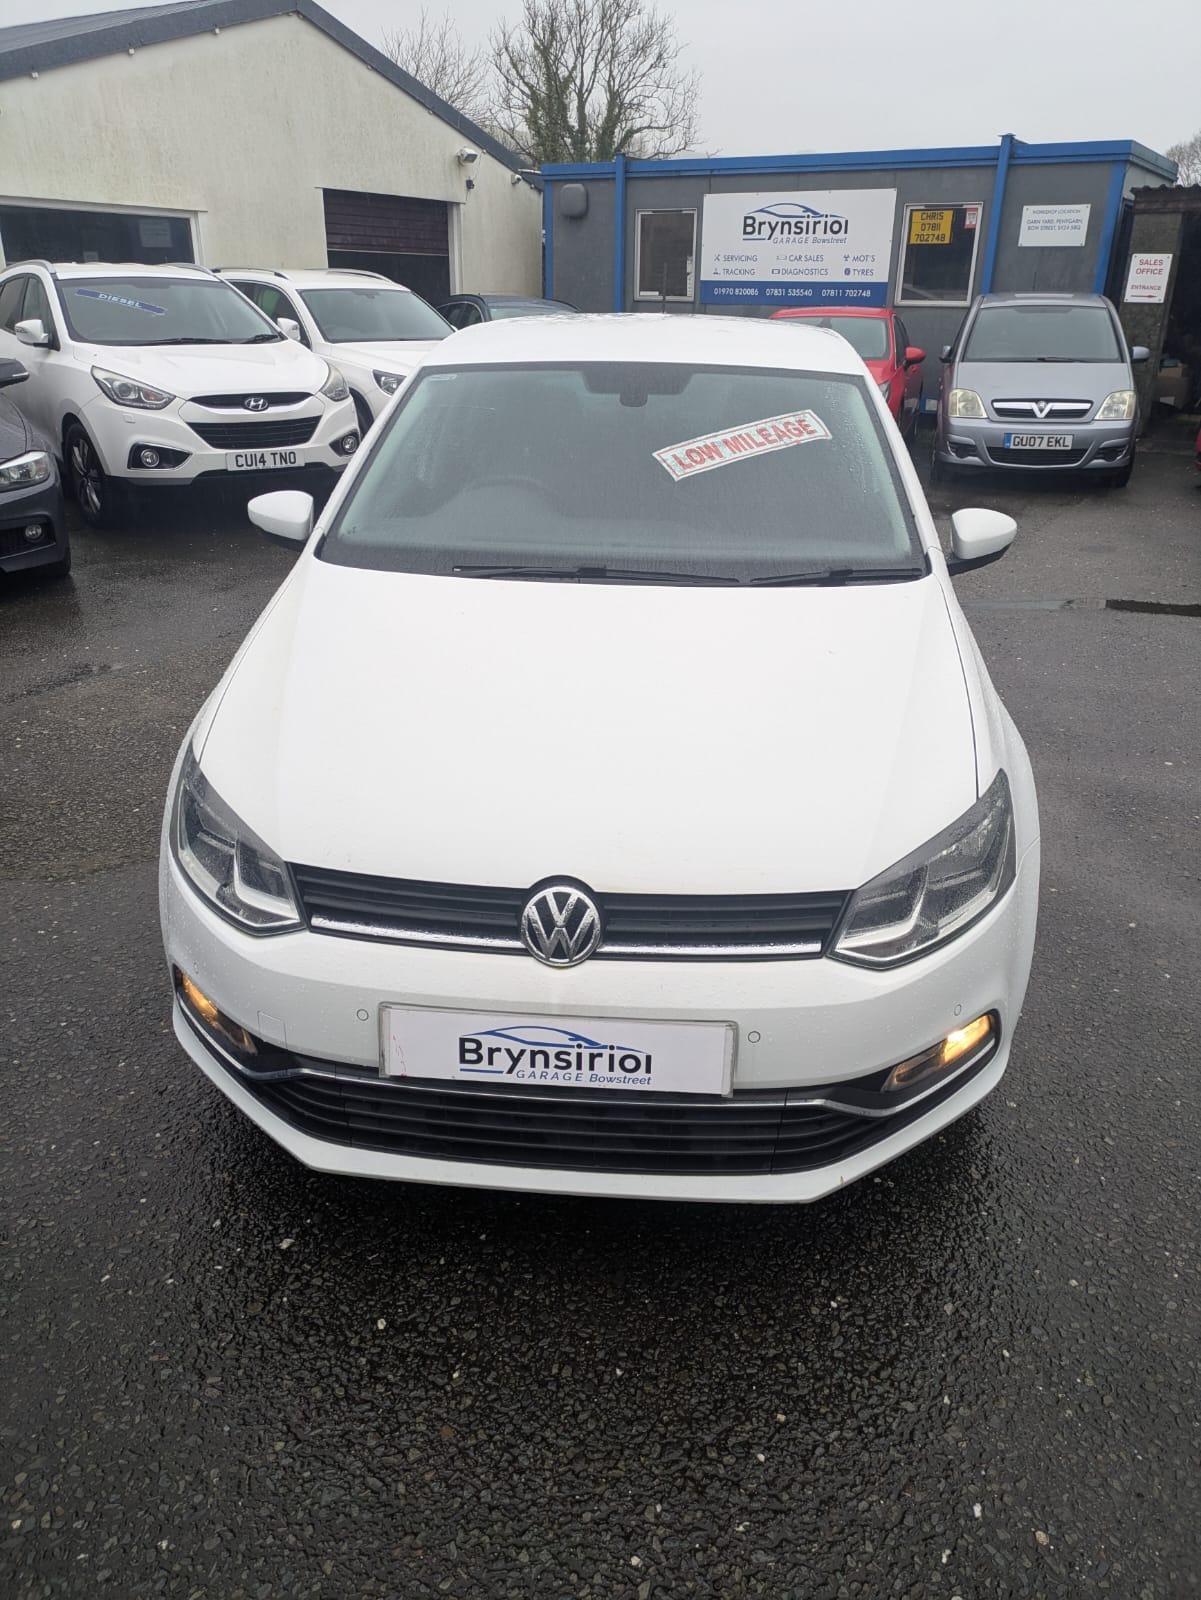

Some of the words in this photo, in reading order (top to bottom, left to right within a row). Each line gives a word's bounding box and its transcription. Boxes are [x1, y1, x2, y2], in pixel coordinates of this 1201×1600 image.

[921, 211, 944, 220] CHRIS
[743, 214, 848, 240] Brynsiriol
[920, 223, 941, 231] 07811
[812, 236, 847, 244] Bowstreet
[915, 233, 945, 242] 702748
[723, 254, 758, 262] SERVICING
[788, 254, 803, 262] CAR
[804, 254, 824, 262] SALES
[722, 268, 756, 276] TRACKING
[781, 268, 829, 276] DIAGNOSTICS
[852, 268, 874, 276] TYRES
[713, 288, 734, 296] 01970
[734, 288, 759, 296] 820086
[766, 288, 785, 296] 07831
[787, 289, 813, 297] 535540
[821, 289, 842, 297] 07811
[845, 289, 871, 297] 702748
[98, 292, 143, 309] DIESEL
[671, 442, 724, 470] LOW
[722, 418, 818, 455] MILEAGE
[1013, 434, 1044, 450] GU07
[1047, 434, 1070, 450] EKL
[235, 452, 267, 468] CU14
[270, 450, 297, 466] TNO
[459, 1036, 652, 1075] Brynsiriol
[516, 1069, 584, 1083] GARAGE
[589, 1073, 652, 1086] Bowstreet
